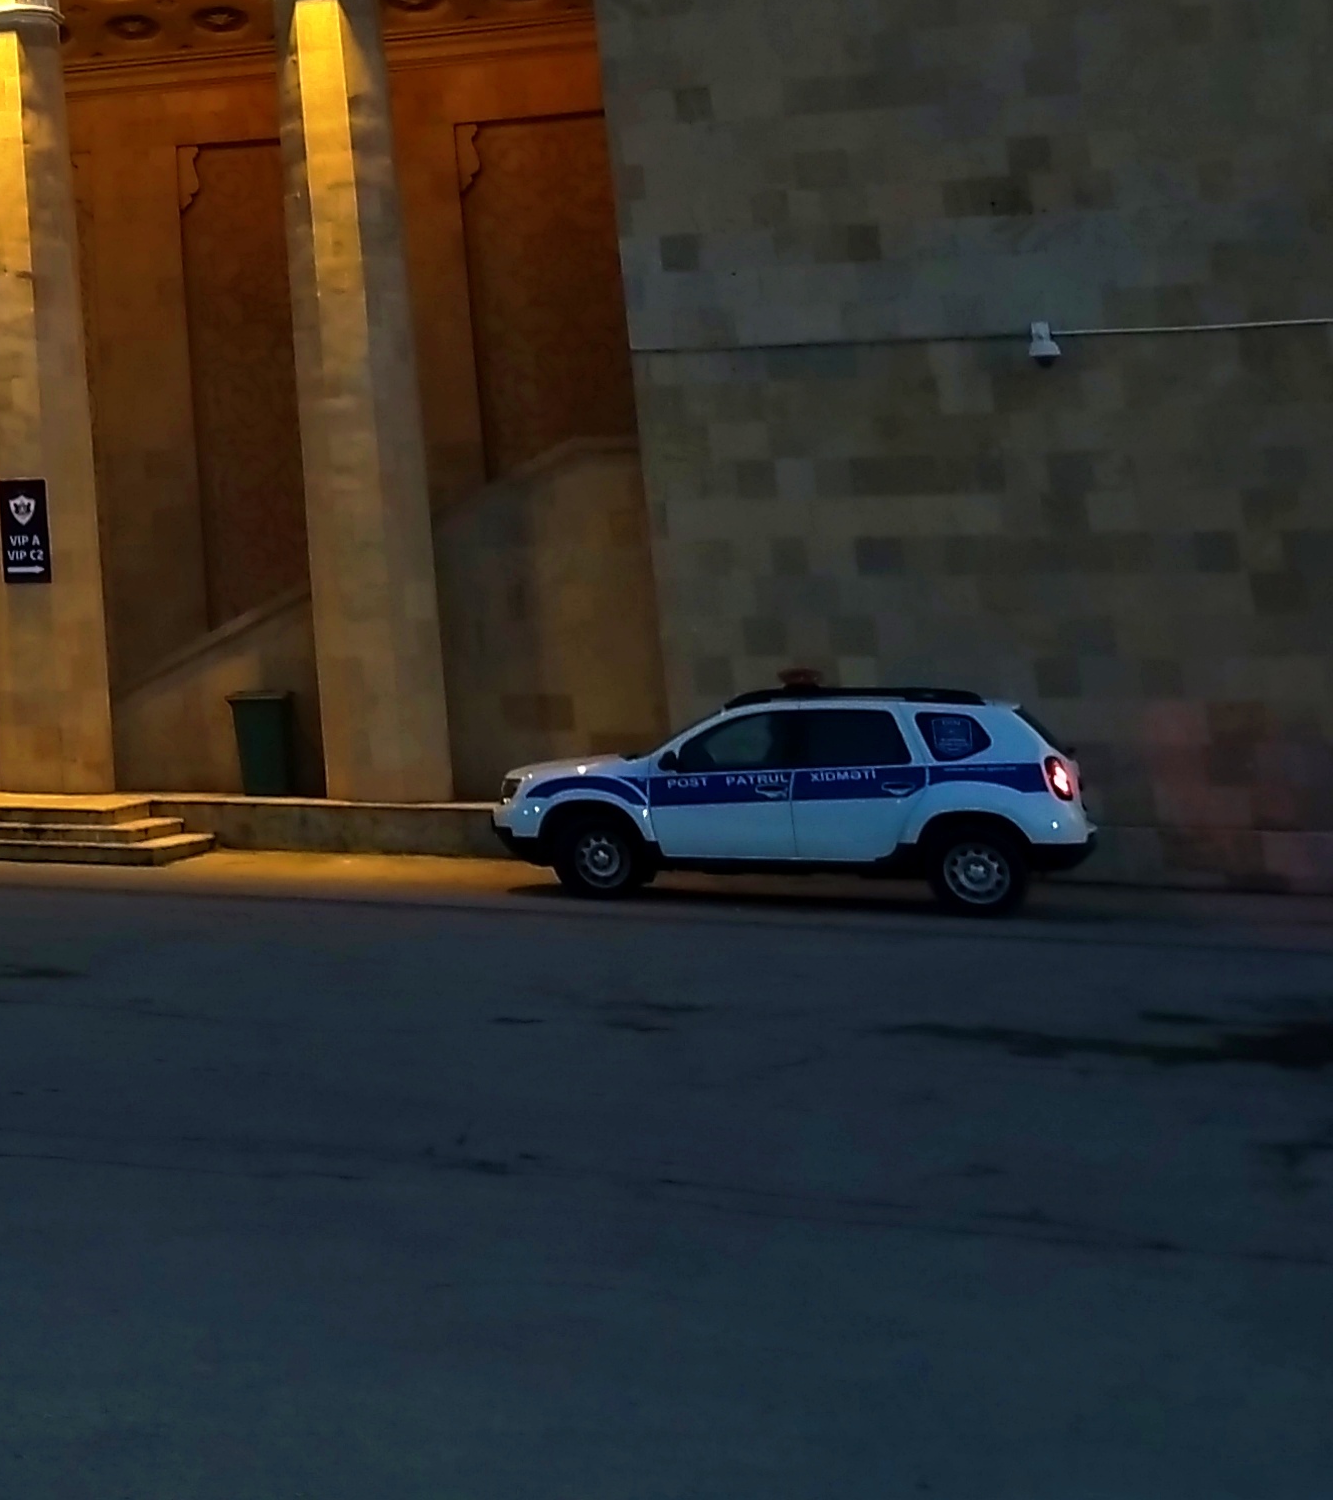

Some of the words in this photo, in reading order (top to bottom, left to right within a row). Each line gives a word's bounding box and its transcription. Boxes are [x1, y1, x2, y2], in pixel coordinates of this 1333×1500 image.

[9, 534, 29, 547] VIP
[32, 534, 40, 546] A
[7, 549, 27, 561] VIP
[30, 549, 44, 561] C2
[667, 776, 708, 789] POST
[725, 771, 788, 787] PATRUL
